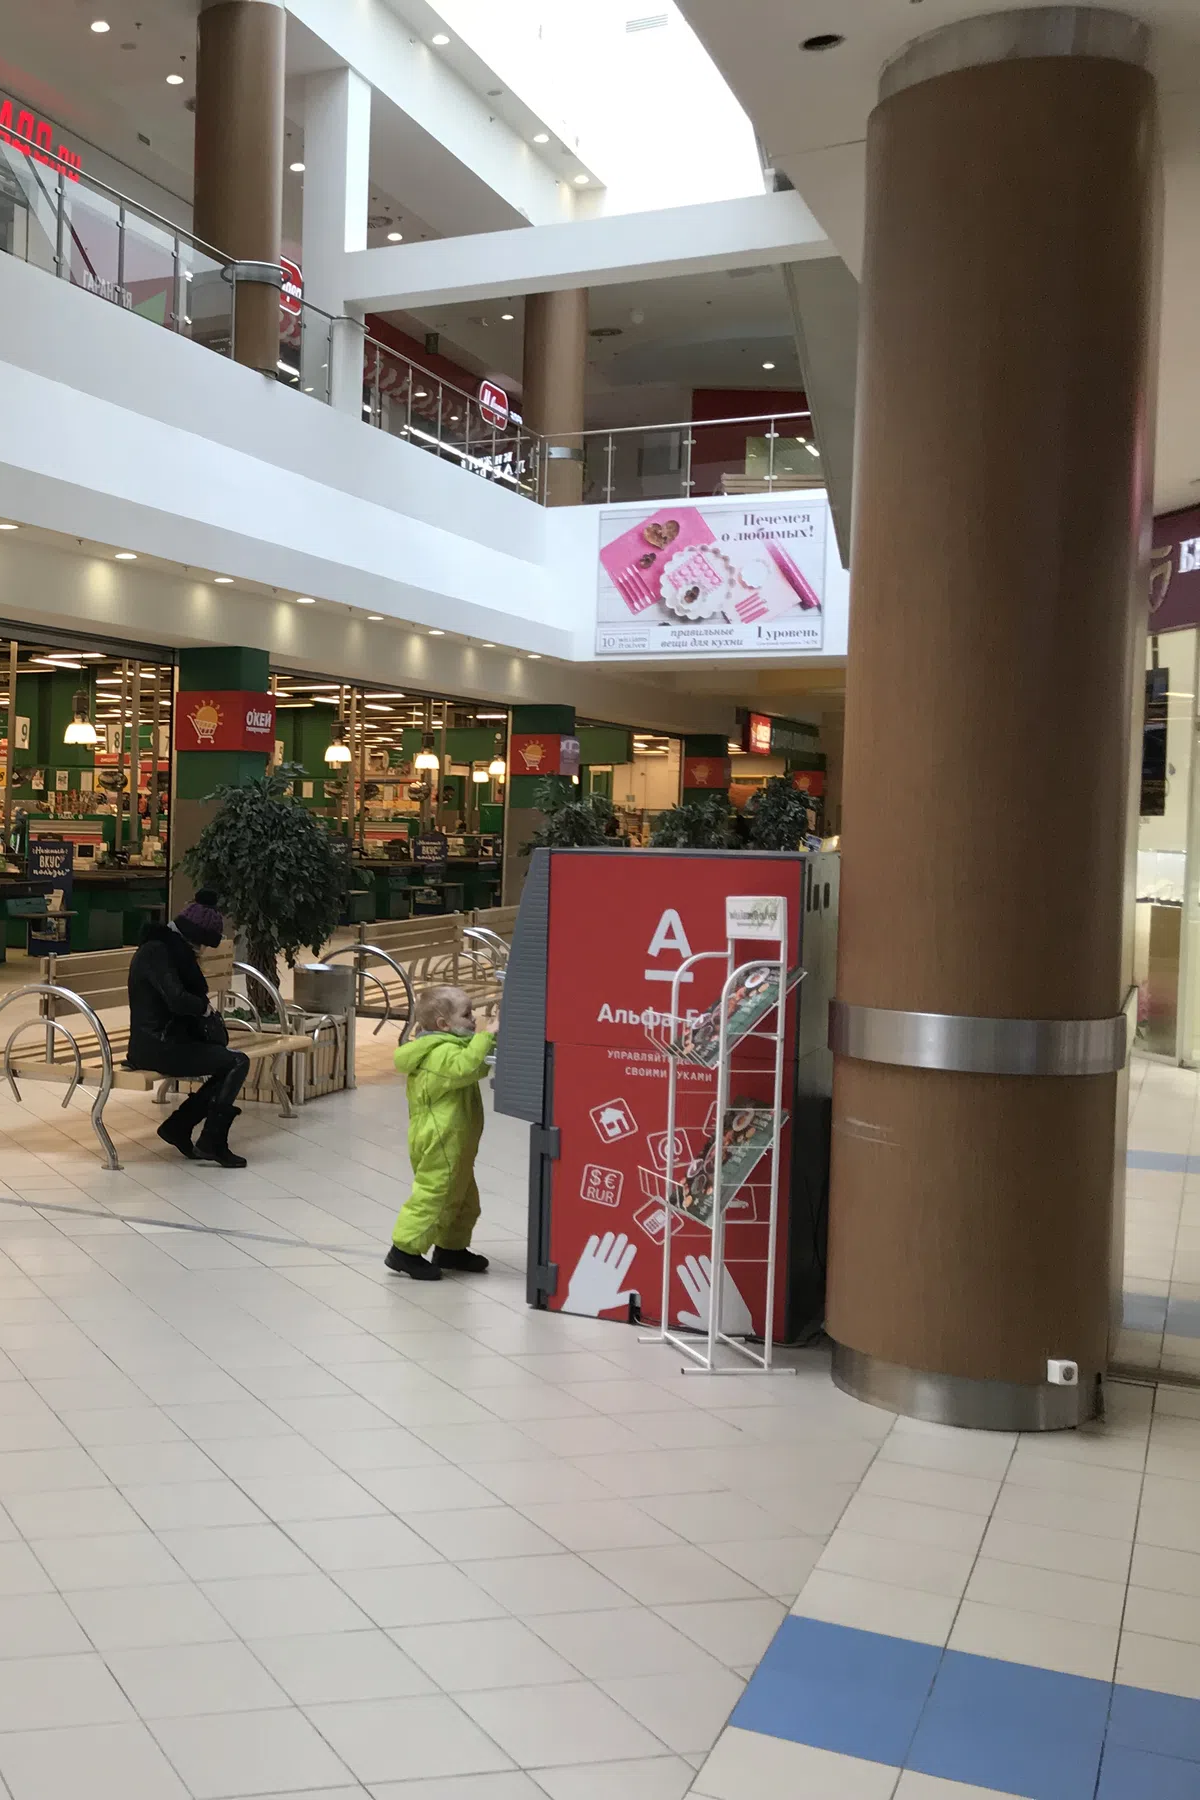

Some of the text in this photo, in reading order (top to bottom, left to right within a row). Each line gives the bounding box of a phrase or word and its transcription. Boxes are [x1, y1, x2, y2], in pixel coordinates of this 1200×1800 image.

[743, 514, 811, 526] Печемся
[721, 525, 814, 541] о любимых!
[670, 628, 734, 639] правильные
[765, 629, 819, 641] уровень
[660, 638, 744, 649] вещи для кухни
[21, 723, 28, 743] 9
[114, 731, 120, 748] 8
[39, 855, 61, 868] ВКУС
[607, 1050, 672, 1063] УПРАВЛЯЙТ
[625, 1066, 713, 1082] СВОИМИ УКАМИ
[587, 1186, 614, 1203] RUR
